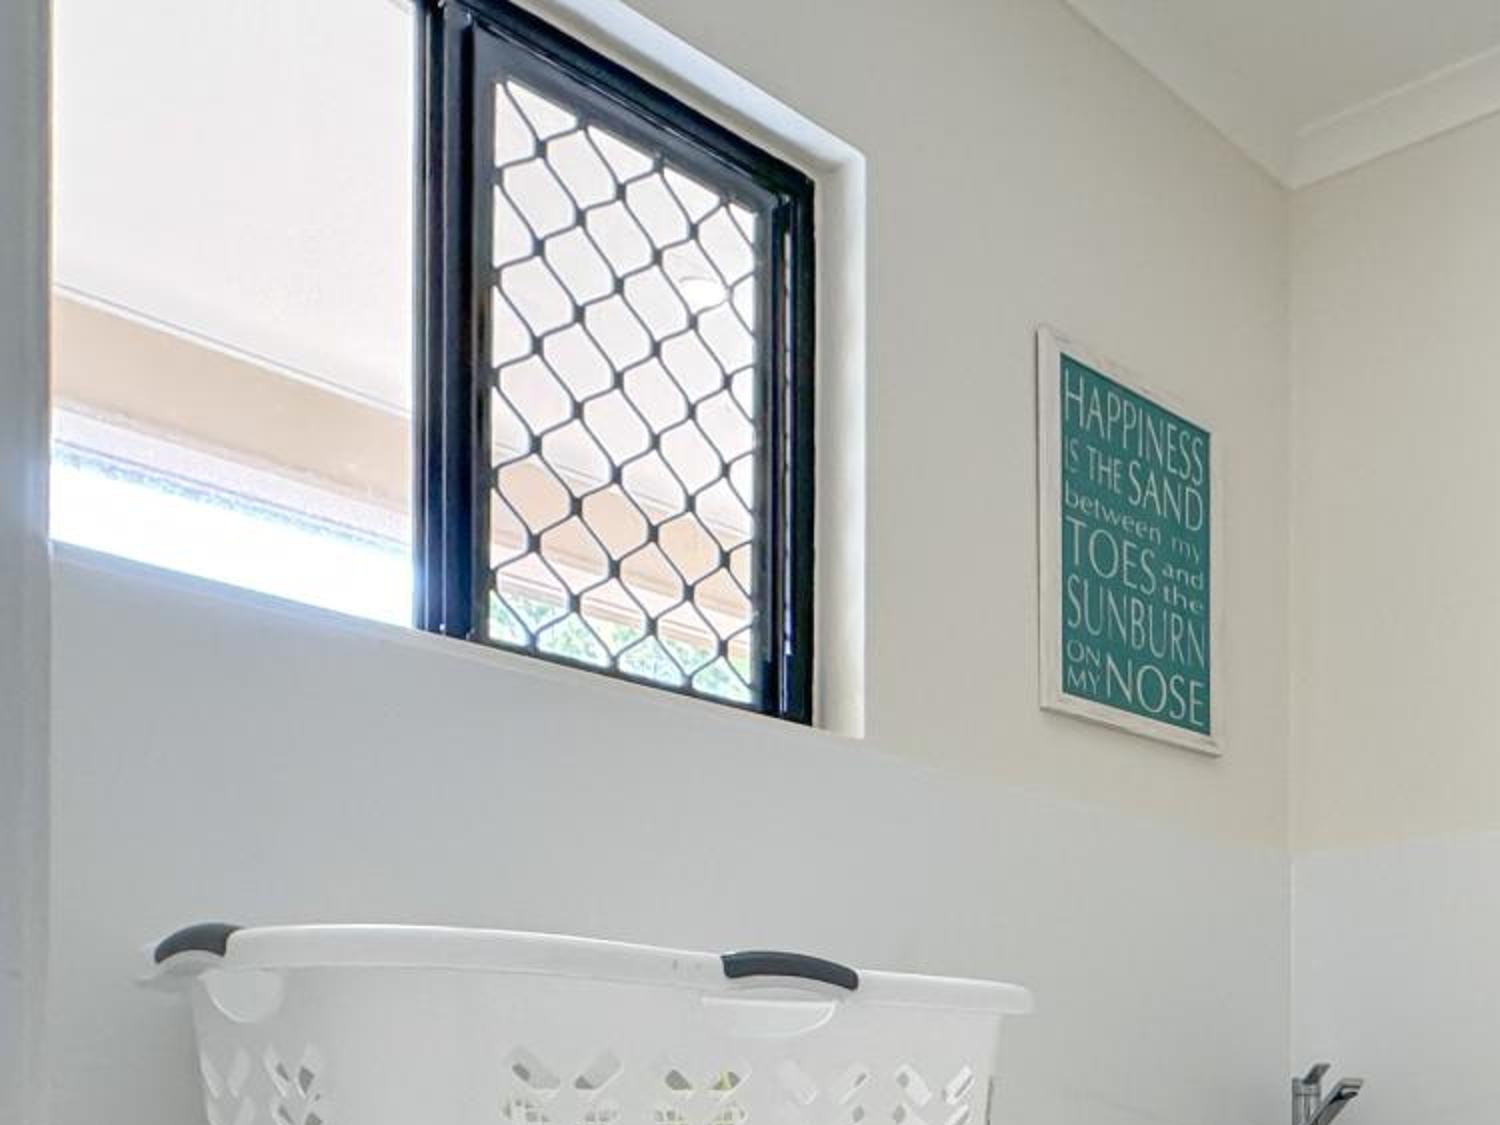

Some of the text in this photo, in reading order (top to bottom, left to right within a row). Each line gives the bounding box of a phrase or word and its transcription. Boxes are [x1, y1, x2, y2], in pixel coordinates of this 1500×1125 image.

[1064, 366, 1204, 488] HAPPINESS
[1064, 480, 1201, 563] between my
[1087, 445, 1122, 494] THE
[1128, 459, 1204, 532] SAND
[1066, 515, 1204, 597] TOES and
[1067, 574, 1205, 671] SUNBURN
[1163, 584, 1204, 613] the
[1067, 639, 1100, 667] ON
[1067, 651, 1205, 728] MY NOSE
